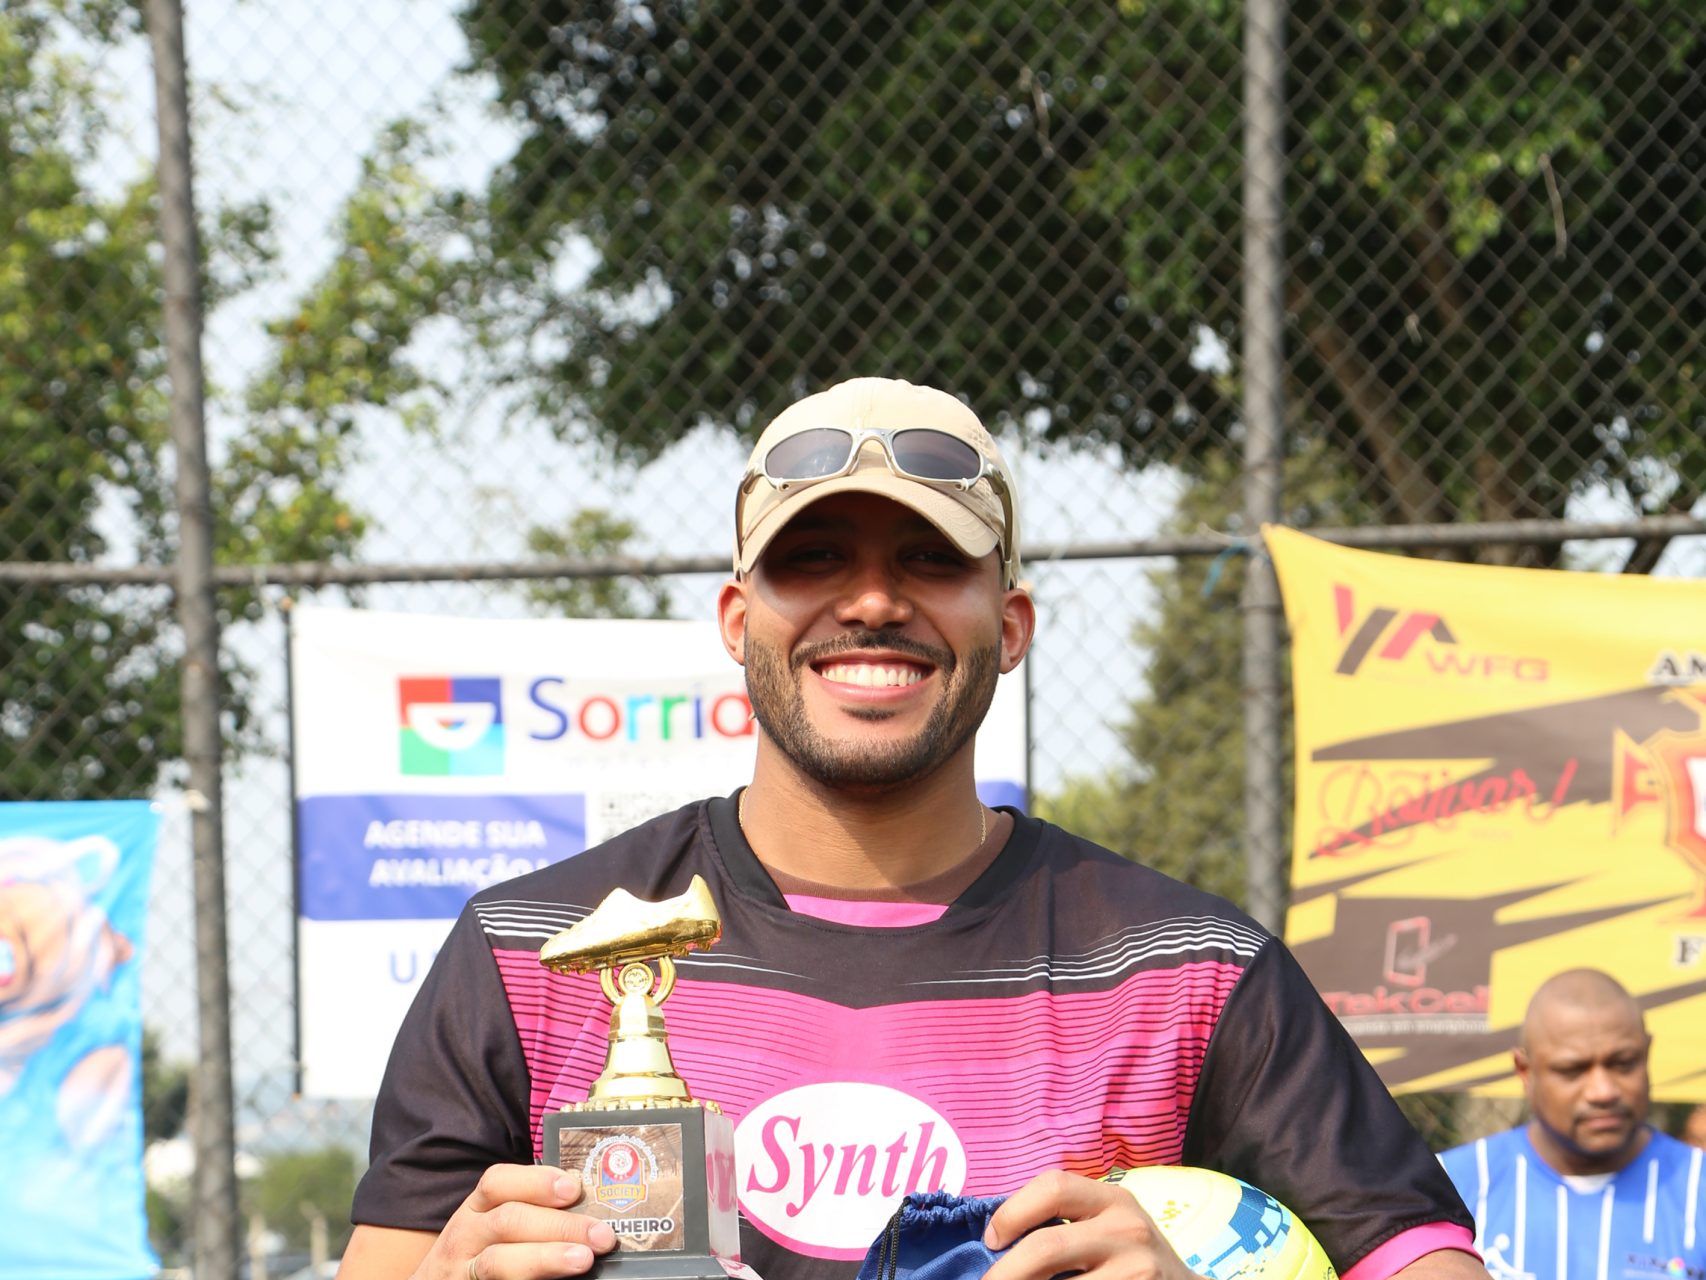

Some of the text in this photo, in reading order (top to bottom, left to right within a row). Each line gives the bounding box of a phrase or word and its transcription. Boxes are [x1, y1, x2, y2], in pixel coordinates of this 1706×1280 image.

[1425, 649, 1550, 682] WFG
[364, 820, 547, 848] AGENDE SUA
[747, 1115, 948, 1217] Synth
[600, 1187, 642, 1197] SOCIETY
